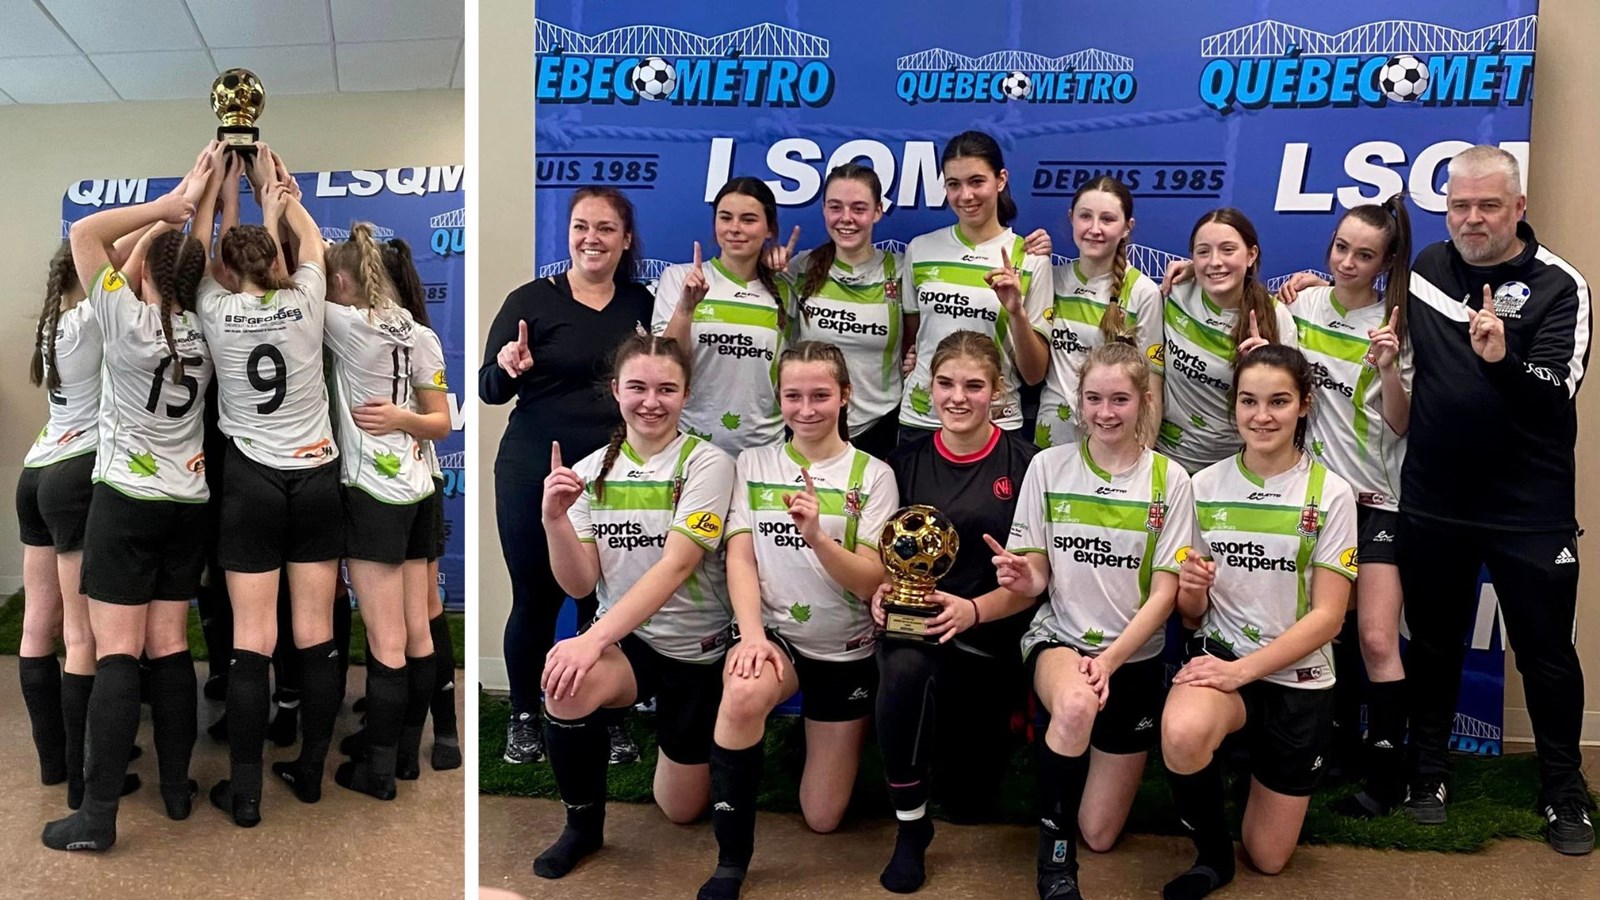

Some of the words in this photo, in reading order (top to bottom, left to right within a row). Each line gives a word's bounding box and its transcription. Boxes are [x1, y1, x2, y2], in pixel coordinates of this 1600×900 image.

[537, 160, 581, 181] UIS
[590, 160, 659, 182] 1985
[1152, 169, 1226, 191] 1985
[1275, 139, 1529, 213] LSQ
[919, 289, 970, 308] sports
[806, 303, 857, 322] sports
[933, 302, 997, 323] experts
[817, 316, 888, 336] experts
[1051, 328, 1078, 342] orts
[698, 331, 754, 347] sports
[717, 343, 774, 362] experts
[1167, 338, 1208, 373] sports
[247, 343, 287, 415] 9
[1173, 358, 1230, 392] experts
[145, 354, 204, 419] 15
[592, 520, 642, 539] sports
[691, 513, 720, 533] Leon
[608, 532, 667, 551] expert
[1054, 534, 1112, 553] sports
[1210, 541, 1265, 557] sports
[1073, 549, 1141, 570] experts
[1226, 554, 1296, 573] experts
